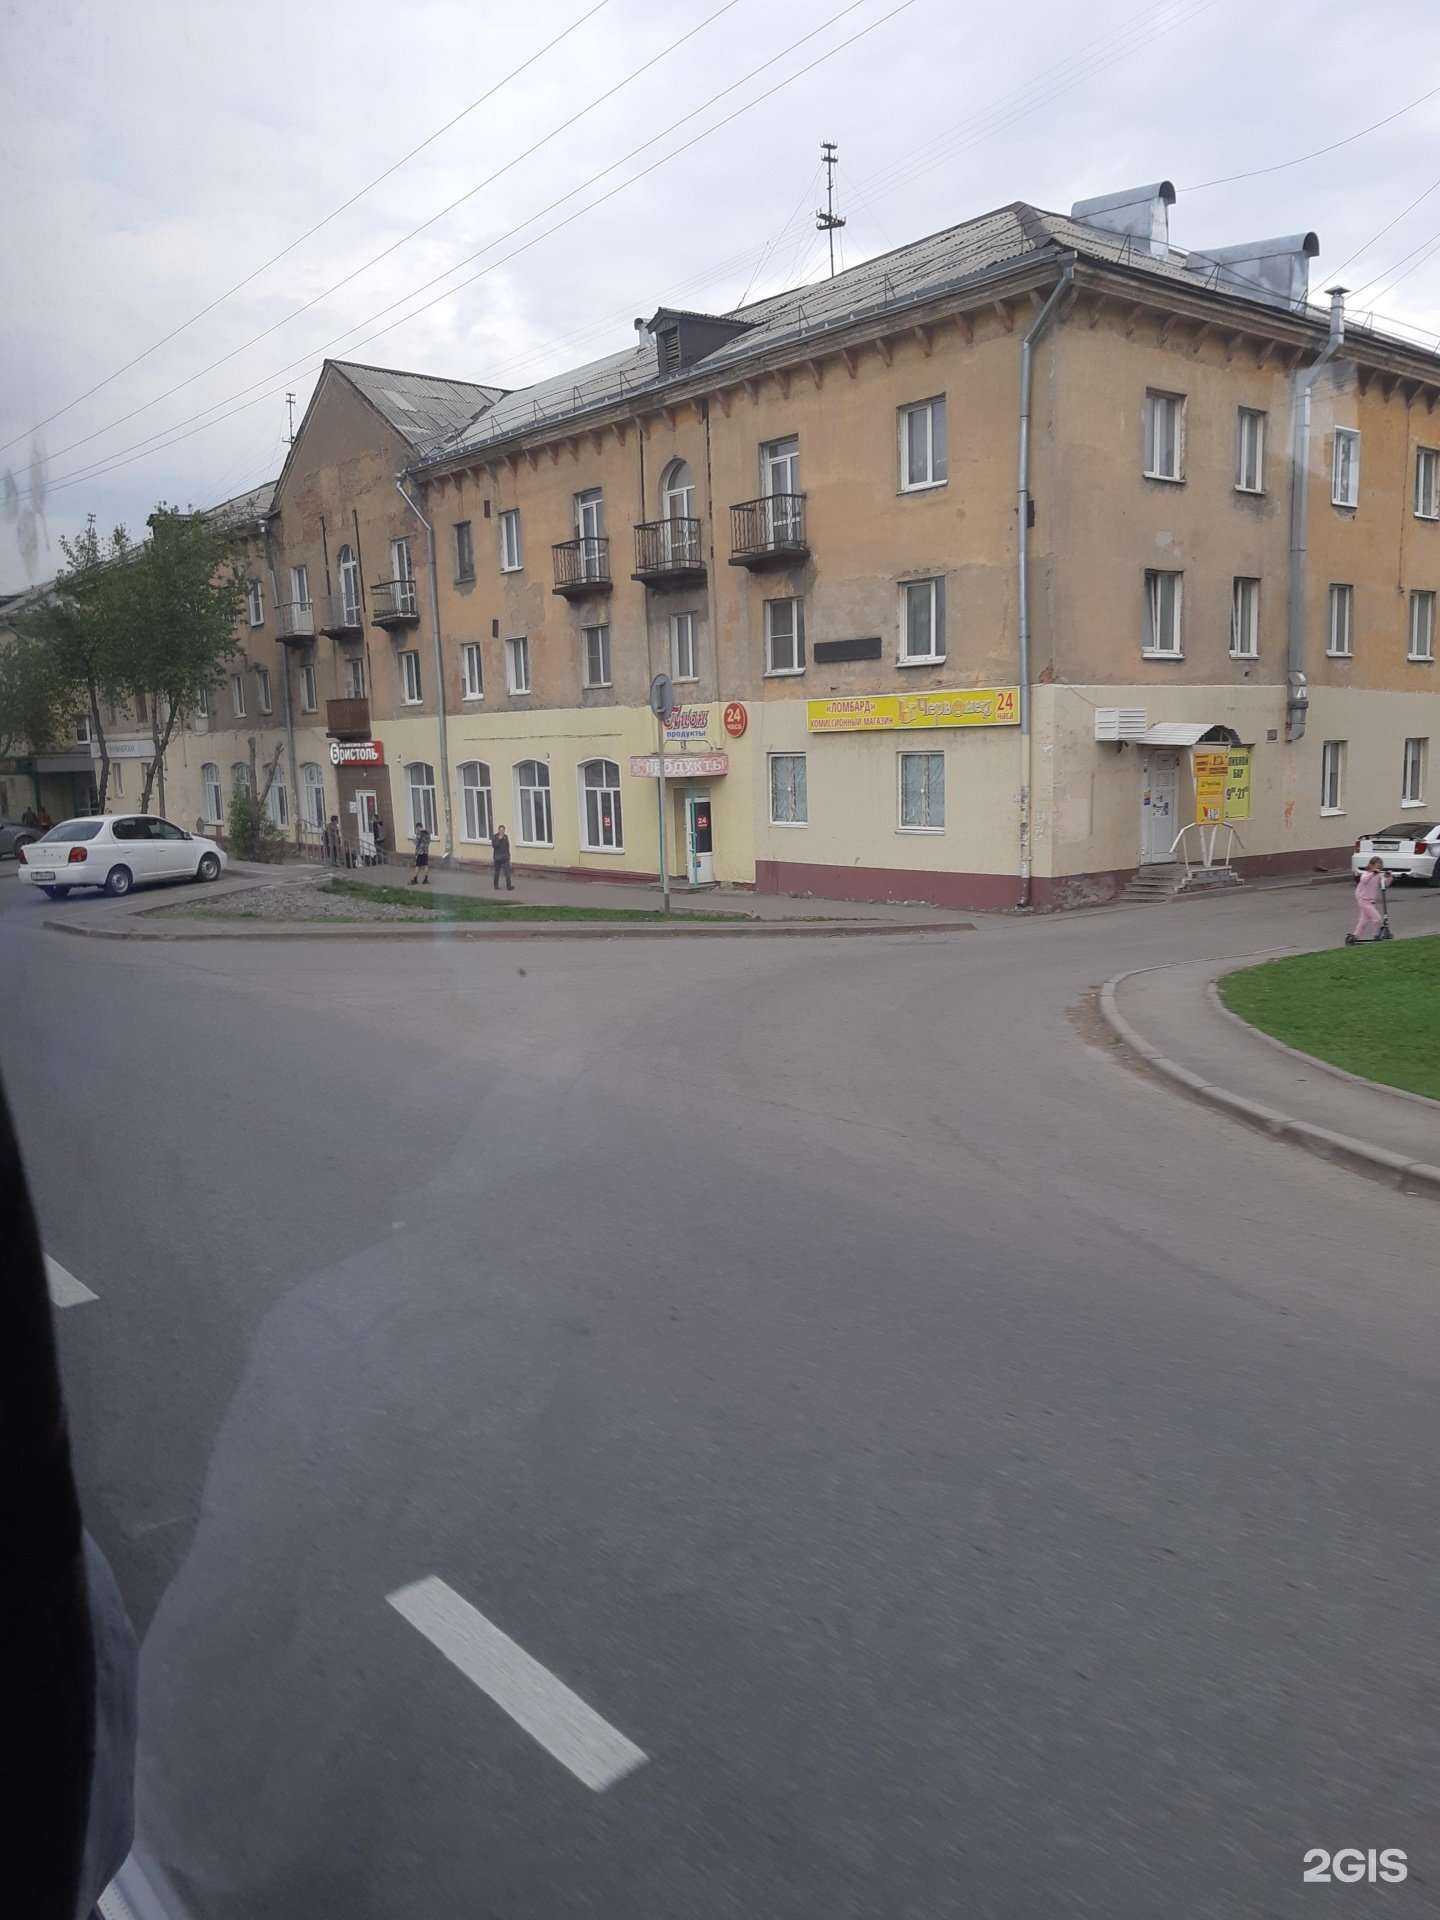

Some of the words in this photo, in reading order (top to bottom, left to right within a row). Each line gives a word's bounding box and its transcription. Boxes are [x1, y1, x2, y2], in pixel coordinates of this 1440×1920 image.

[827, 701, 876, 713] «ЛОМБАРД»
[998, 693, 1013, 710] 24
[727, 708, 741, 722] 24
